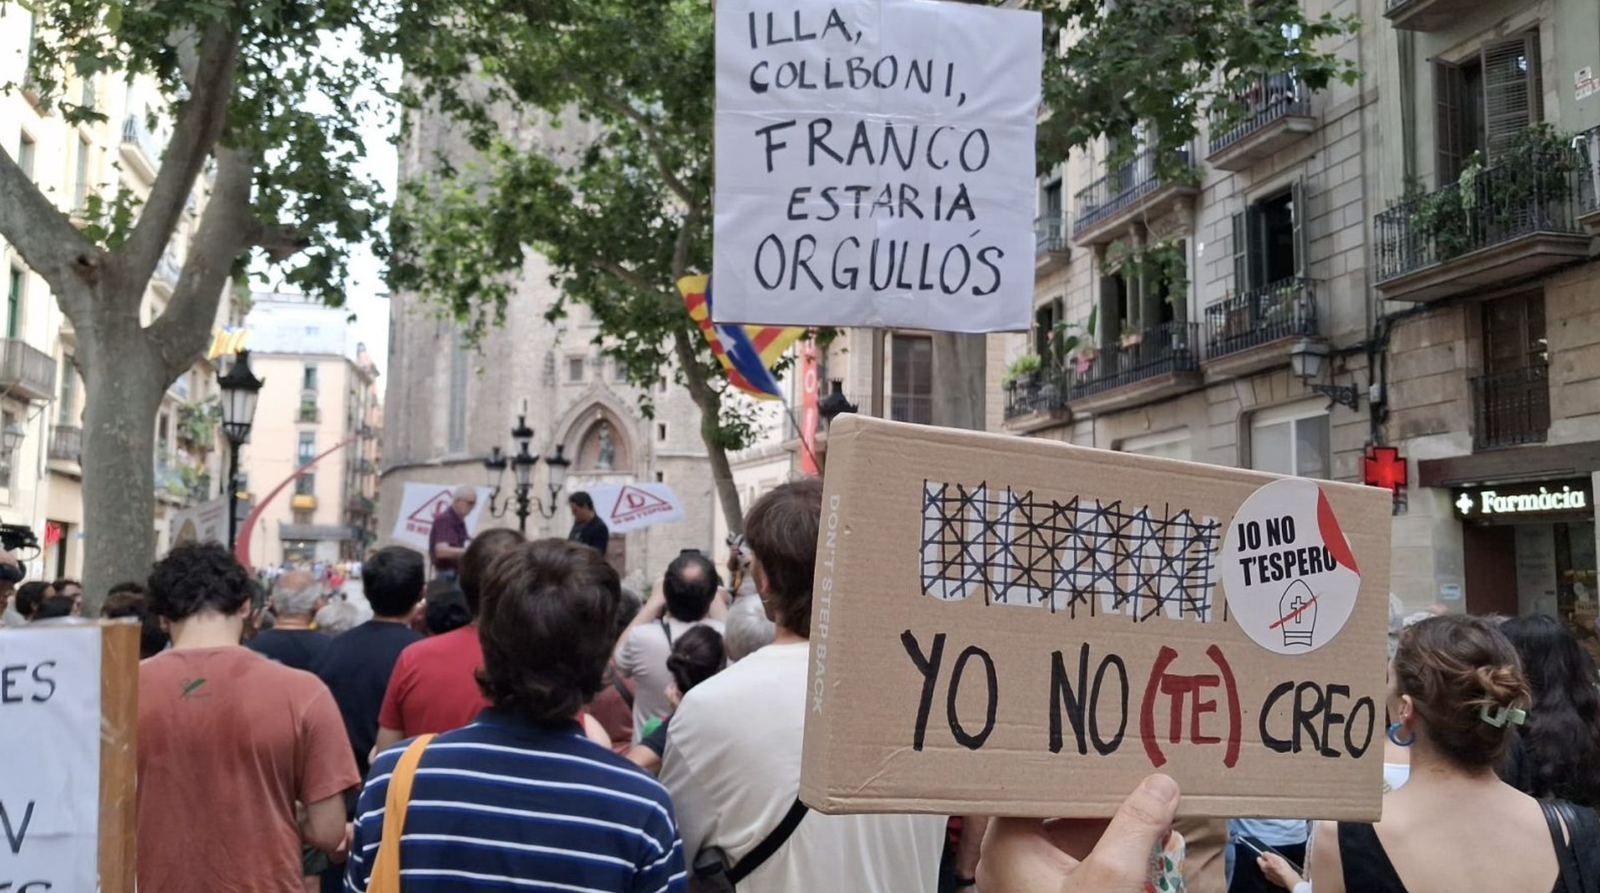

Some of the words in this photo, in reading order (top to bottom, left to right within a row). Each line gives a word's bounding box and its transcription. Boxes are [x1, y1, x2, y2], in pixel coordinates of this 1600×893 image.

[749, 8, 862, 49] ILLA,
[755, 117, 990, 173] FRANCO
[787, 183, 976, 221] ESTARIA
[754, 229, 1004, 296] ORGULLÓS
[1480, 486, 1586, 514] Farmàcia
[825, 494, 840, 571] DON'T
[1237, 521, 1262, 552] JO
[1266, 515, 1296, 547] NO
[1239, 545, 1338, 587] T'ESPERO
[819, 577, 833, 639] STEP
[812, 643, 827, 715] BACK
[900, 629, 998, 752] YO
[1049, 642, 1129, 755] NO
[1140, 644, 1242, 768] (TE)
[1259, 681, 1375, 758] CREO
